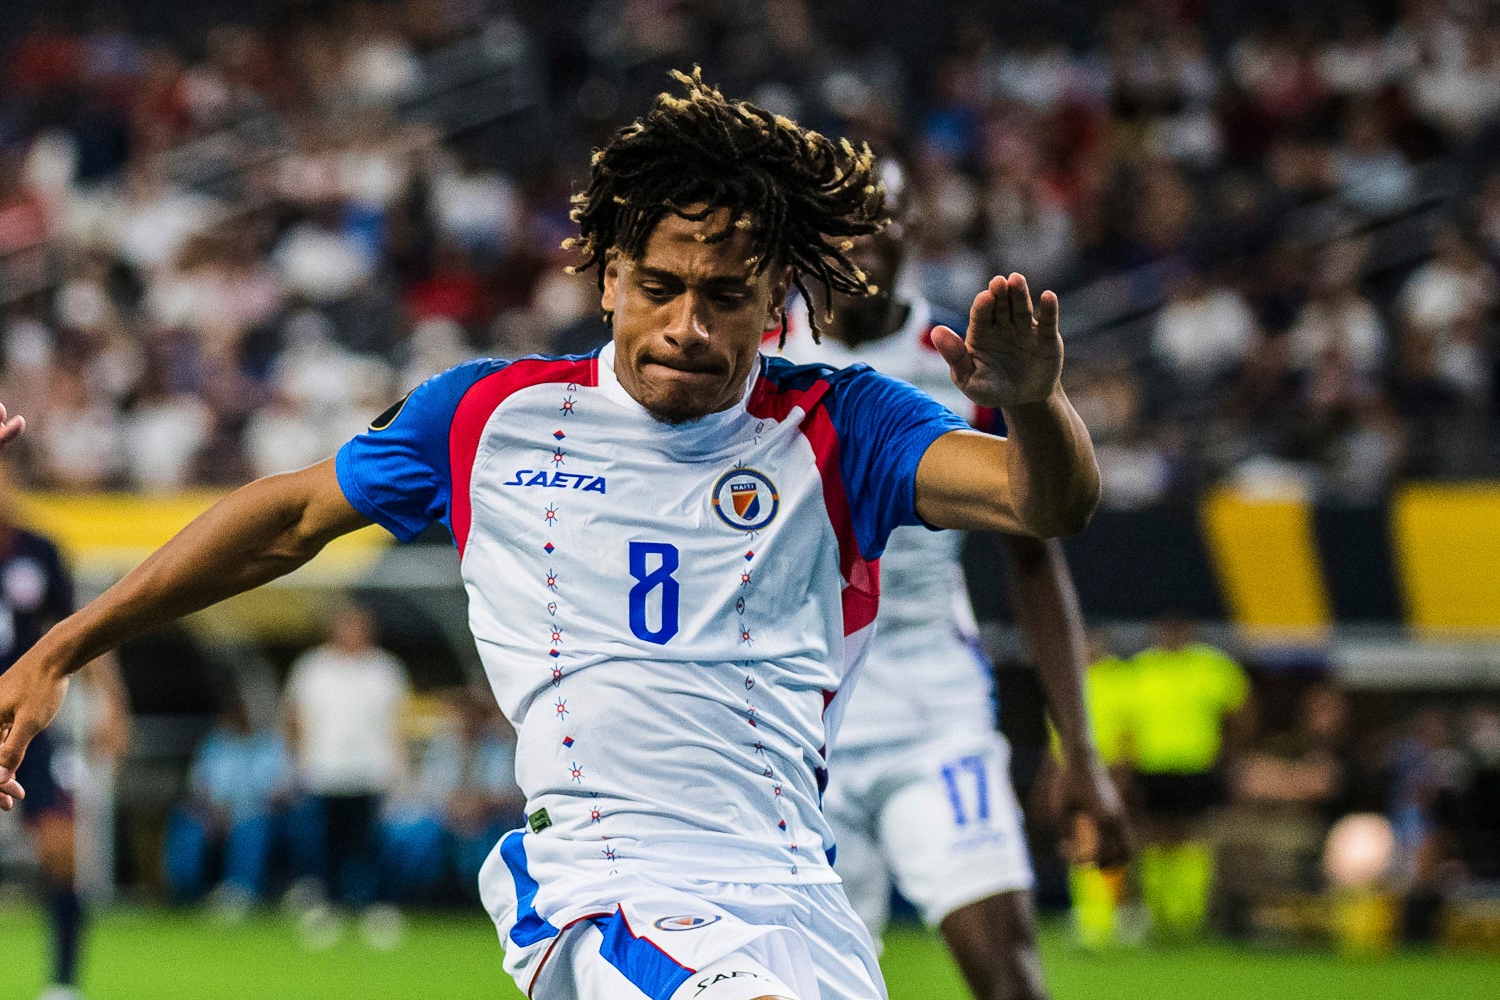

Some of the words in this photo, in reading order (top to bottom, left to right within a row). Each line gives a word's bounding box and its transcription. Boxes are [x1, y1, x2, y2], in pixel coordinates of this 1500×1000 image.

[502, 469, 606, 494] SAETA
[628, 541, 680, 646] 8
[940, 755, 989, 825] 17
